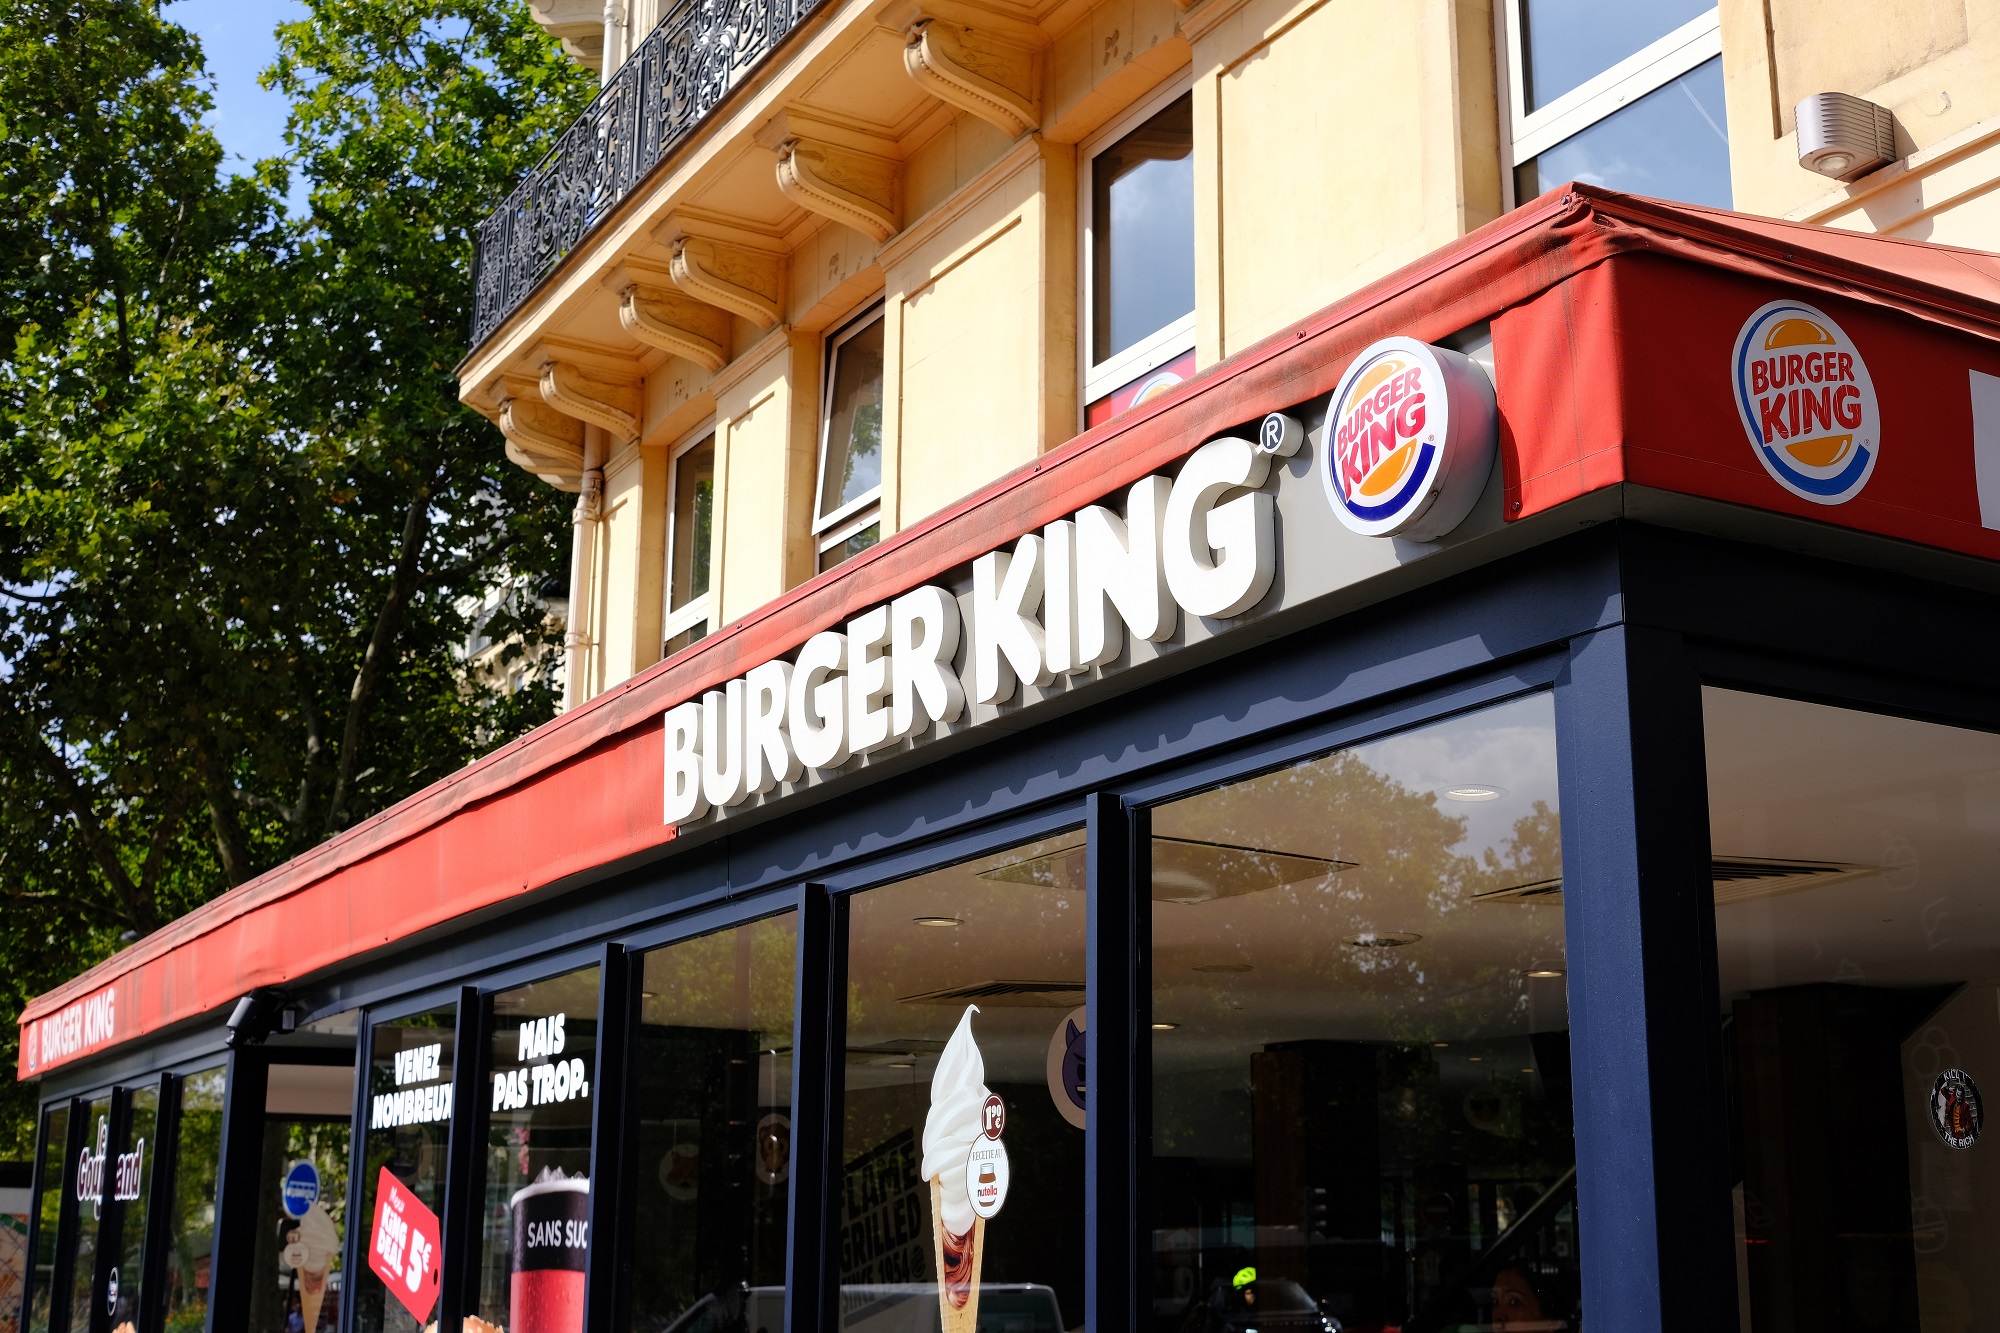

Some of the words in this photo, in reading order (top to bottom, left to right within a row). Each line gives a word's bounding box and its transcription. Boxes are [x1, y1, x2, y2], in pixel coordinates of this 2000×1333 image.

[1752, 352, 1855, 396] BURGER
[1338, 367, 1422, 462] BURGER
[1759, 384, 1862, 444] KING
[1341, 392, 1426, 502] KING
[664, 585, 966, 826] BURGER
[972, 436, 1277, 706] KING
[41, 1003, 82, 1064] BURGER
[83, 987, 115, 1048] KING
[518, 1013, 566, 1061] MAIS
[395, 1043, 441, 1086] VENEZ
[492, 1072, 528, 1112] PAS
[531, 1058, 589, 1108] TROP.
[372, 1083, 453, 1130] NOMBREUX
[972, 1149, 994, 1161] RECETTE
[995, 1148, 1003, 1158] AU
[1944, 1131, 1957, 1147] THE
[1958, 1133, 1974, 1149] RICH
[977, 1187, 998, 1198] nutella
[376, 1226, 403, 1278] DEAL
[527, 1219, 562, 1249] SANS
[840, 1193, 922, 1274] GRILLED
